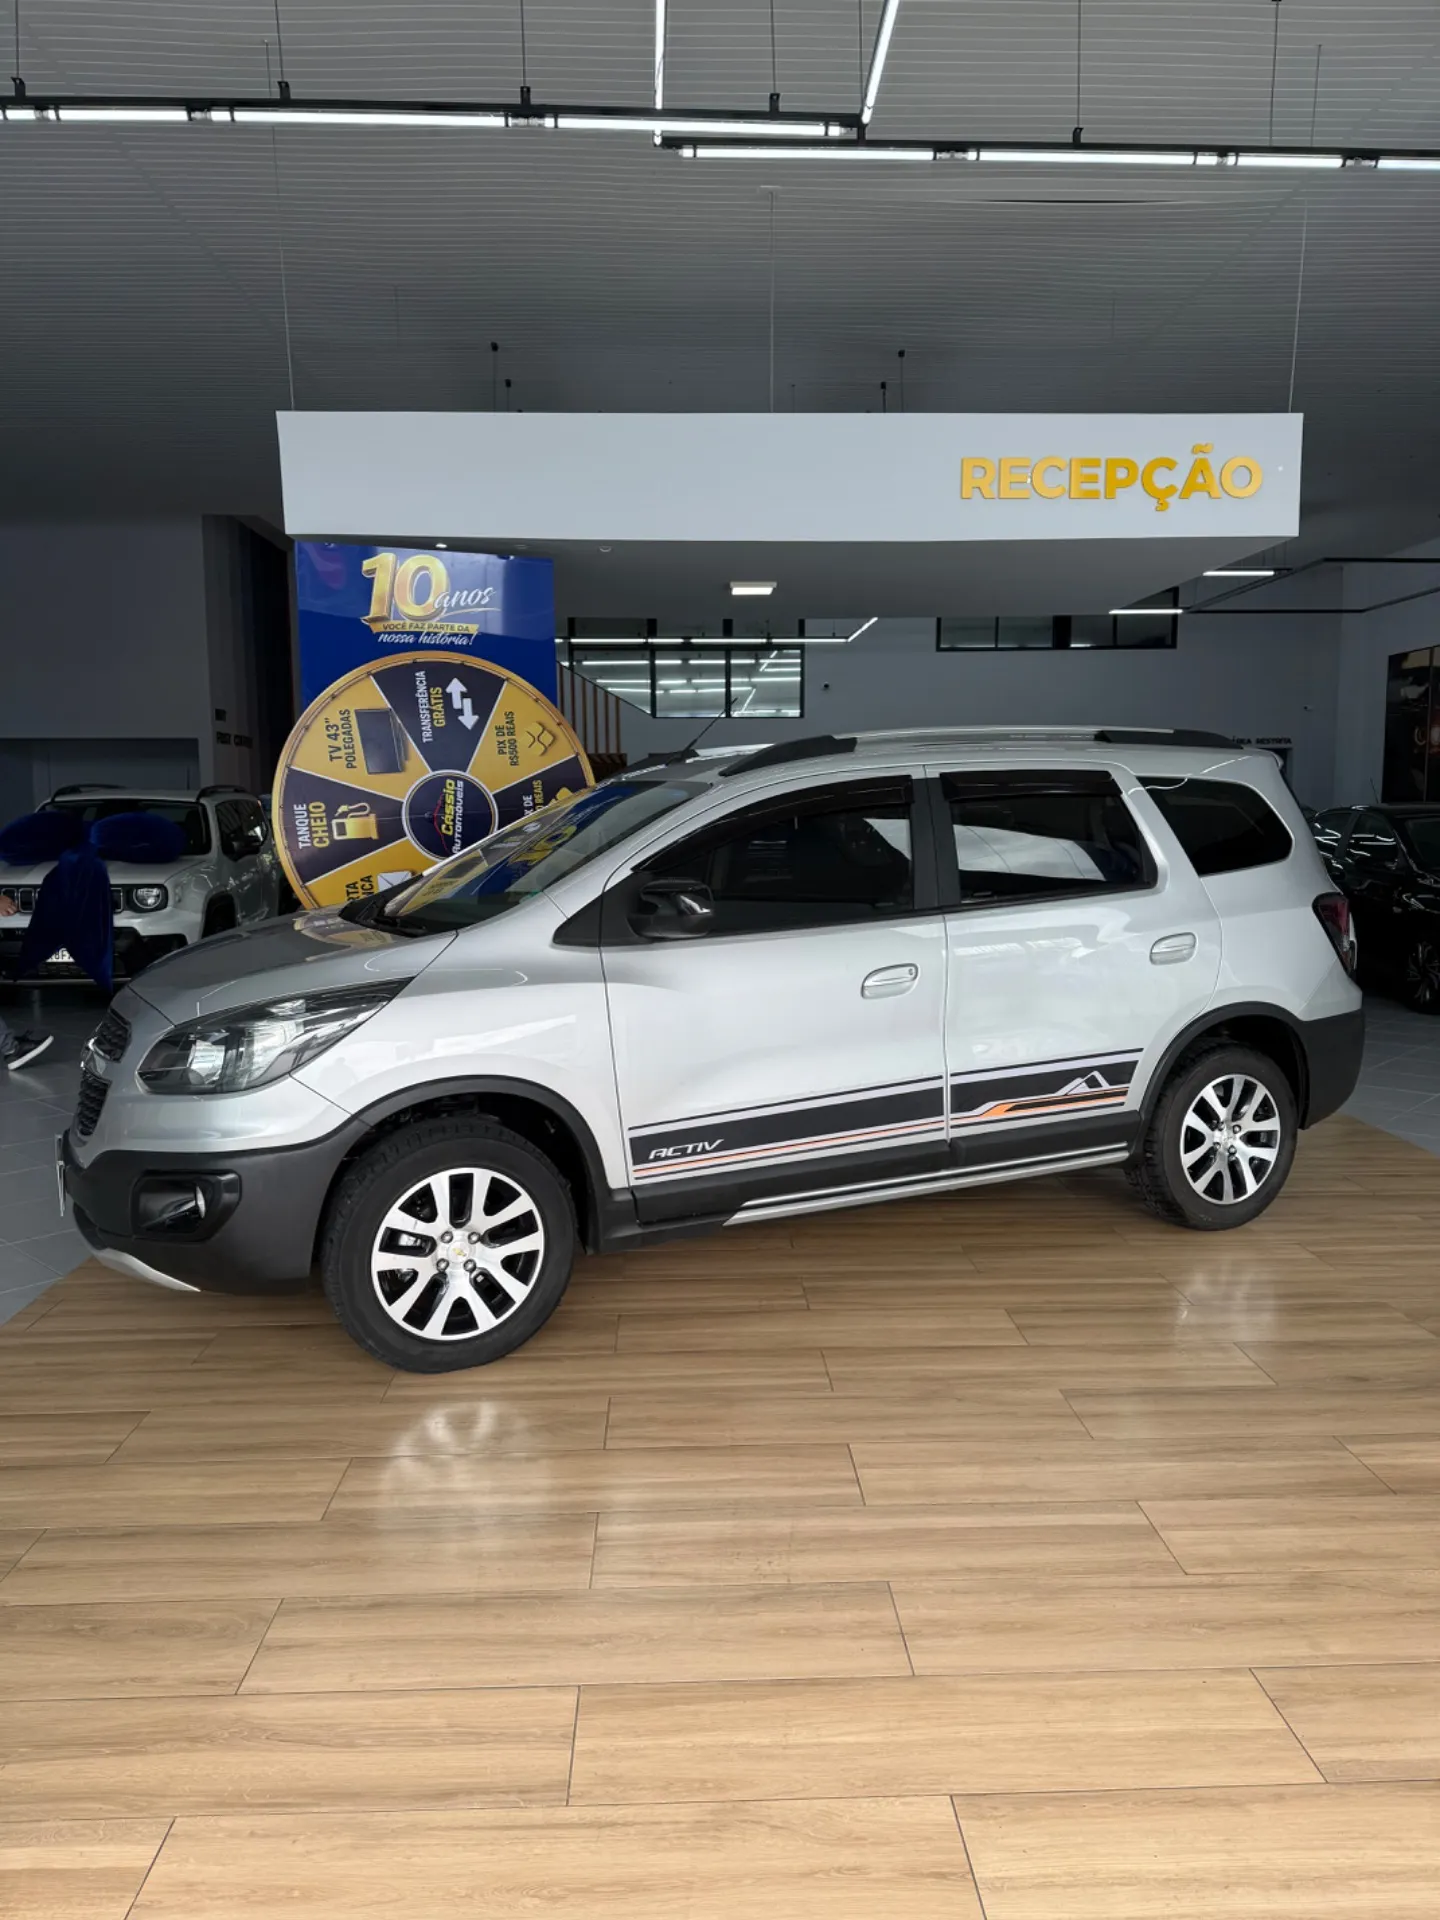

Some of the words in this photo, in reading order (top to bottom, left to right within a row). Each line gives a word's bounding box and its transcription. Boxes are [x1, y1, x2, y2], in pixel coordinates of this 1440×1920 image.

[960, 442, 1264, 511] RECEPÇÃO
[360, 552, 450, 622] 10
[433, 586, 497, 609] anos
[377, 632, 415, 643] nossa
[417, 631, 478, 646] história!
[382, 621, 407, 631] VOCÊ
[409, 622, 426, 631] FAZ
[427, 623, 455, 632] PARTE
[457, 624, 470, 632] DA
[414, 670, 432, 743] TRANSFERÊNCIA
[429, 686, 446, 728] GRÁTIS
[494, 724, 505, 737] DE
[503, 711, 517, 737] REAIS
[341, 708, 357, 769] POLEGADAS
[496, 739, 507, 756] PIX
[328, 744, 343, 762] TV
[522, 794, 533, 807] DE
[532, 779, 545, 804] REAIS
[440, 778, 455, 836] Cássio
[293, 803, 312, 850] TANQUE
[308, 801, 330, 848] CHEIO
[648, 1138, 725, 1160] ACTIV
